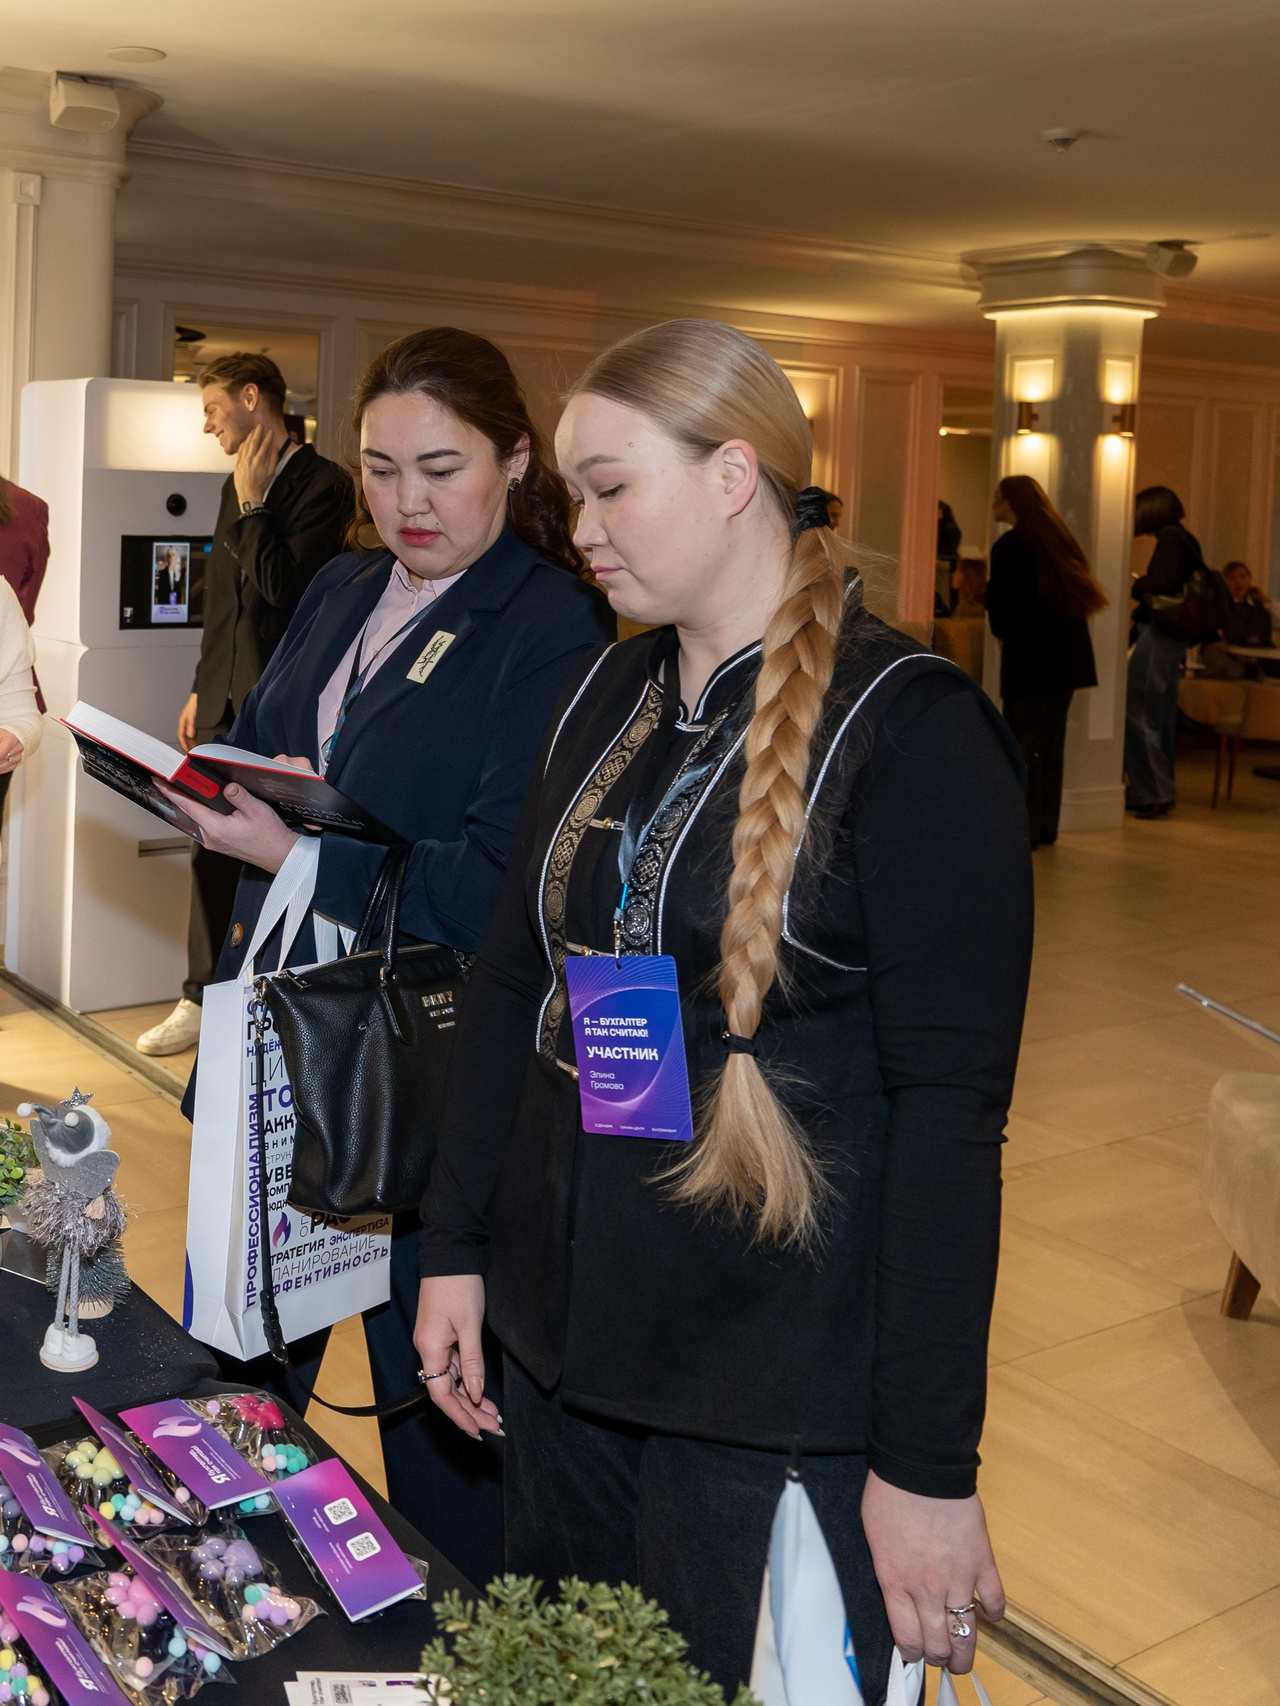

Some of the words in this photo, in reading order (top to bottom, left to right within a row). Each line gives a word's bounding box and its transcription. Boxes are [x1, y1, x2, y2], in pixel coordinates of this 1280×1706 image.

[600, 1018, 648, 1027] БУХГАЛТЕР
[584, 1028, 591, 1036] Я
[592, 1028, 608, 1036] ТАК
[610, 1028, 649, 1038] СЧИТАЮ!
[586, 1046, 659, 1061] УЧАСТНИК
[590, 1080, 624, 1090] Громова
[266, 1150, 293, 1166] СТРУК
[246, 1093, 261, 1308] ПРОФЕССИОНАЛИЗМ
[270, 1238, 325, 1266] ТРАТЕГИЯ
[330, 1216, 390, 1246] ЭКСПЕРТИЗА
[272, 1234, 376, 1282] ЛАНИРОВАНИЕ
[272, 1246, 389, 1298] ФФЕКТИВНОСТЬ
[210, 1474, 231, 1484] Я
